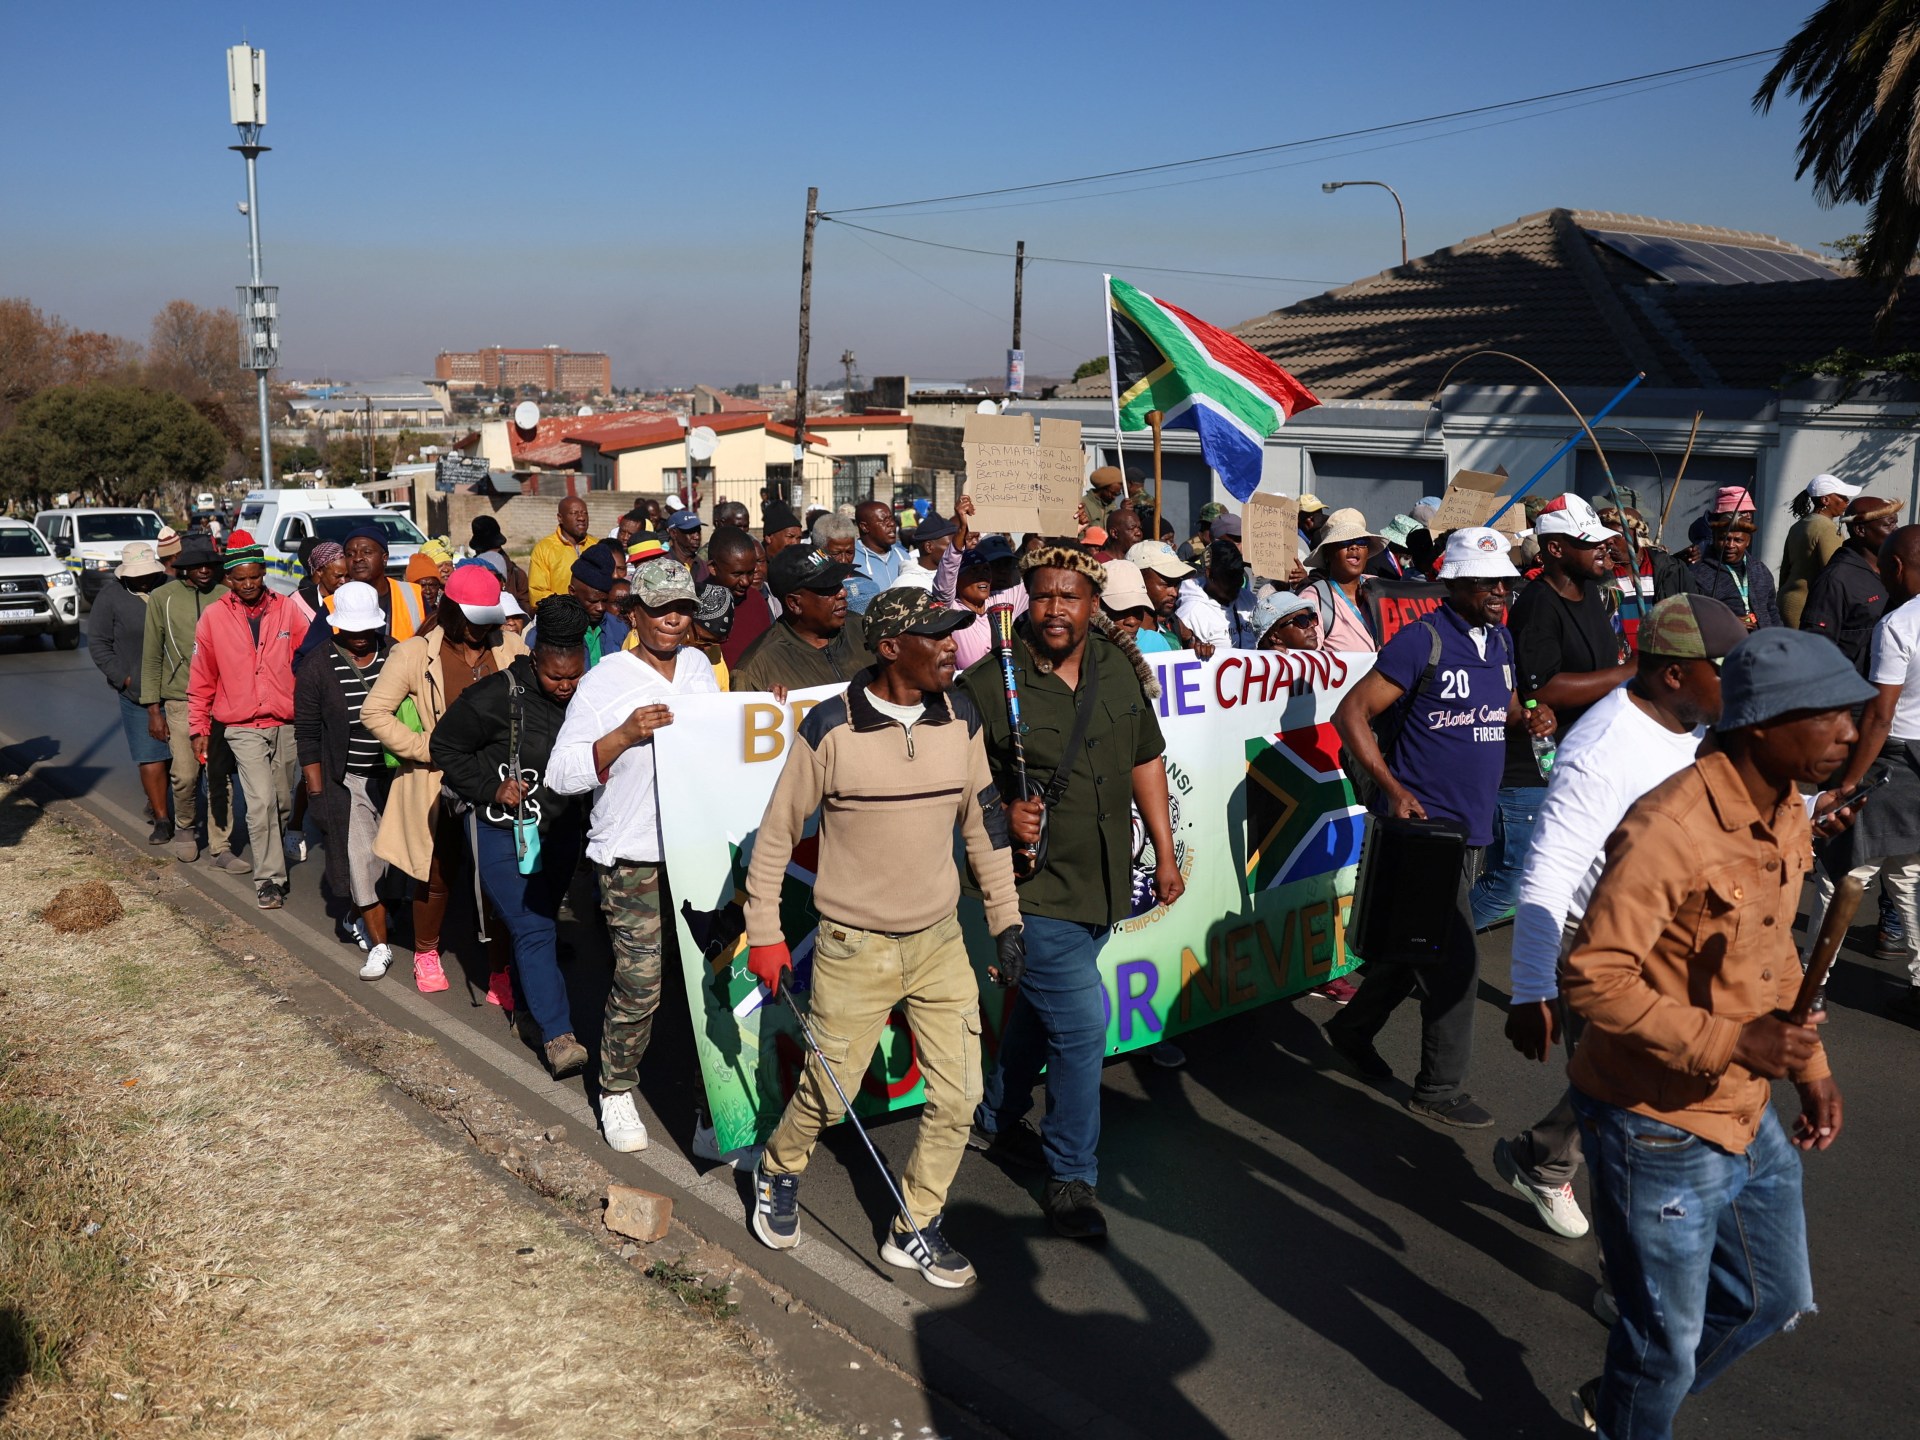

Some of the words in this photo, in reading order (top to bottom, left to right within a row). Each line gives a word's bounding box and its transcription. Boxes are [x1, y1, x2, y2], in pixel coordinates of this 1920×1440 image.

[978, 443, 1054, 458] RAMAPHOSA
[976, 459, 1029, 468] SOMETHING
[1034, 460, 1051, 469] YOU
[976, 470, 1020, 480] BETRAY
[1027, 472, 1050, 481] YOUR
[976, 482, 998, 492] FOR
[975, 493, 1017, 503] ENOUGH
[1020, 493, 1033, 502] IS
[1215, 650, 1348, 709] CHAINS
[1440, 669, 1470, 699] 20
[1428, 708, 1477, 730] Hotel
[1473, 726, 1505, 742] FIRENZE
